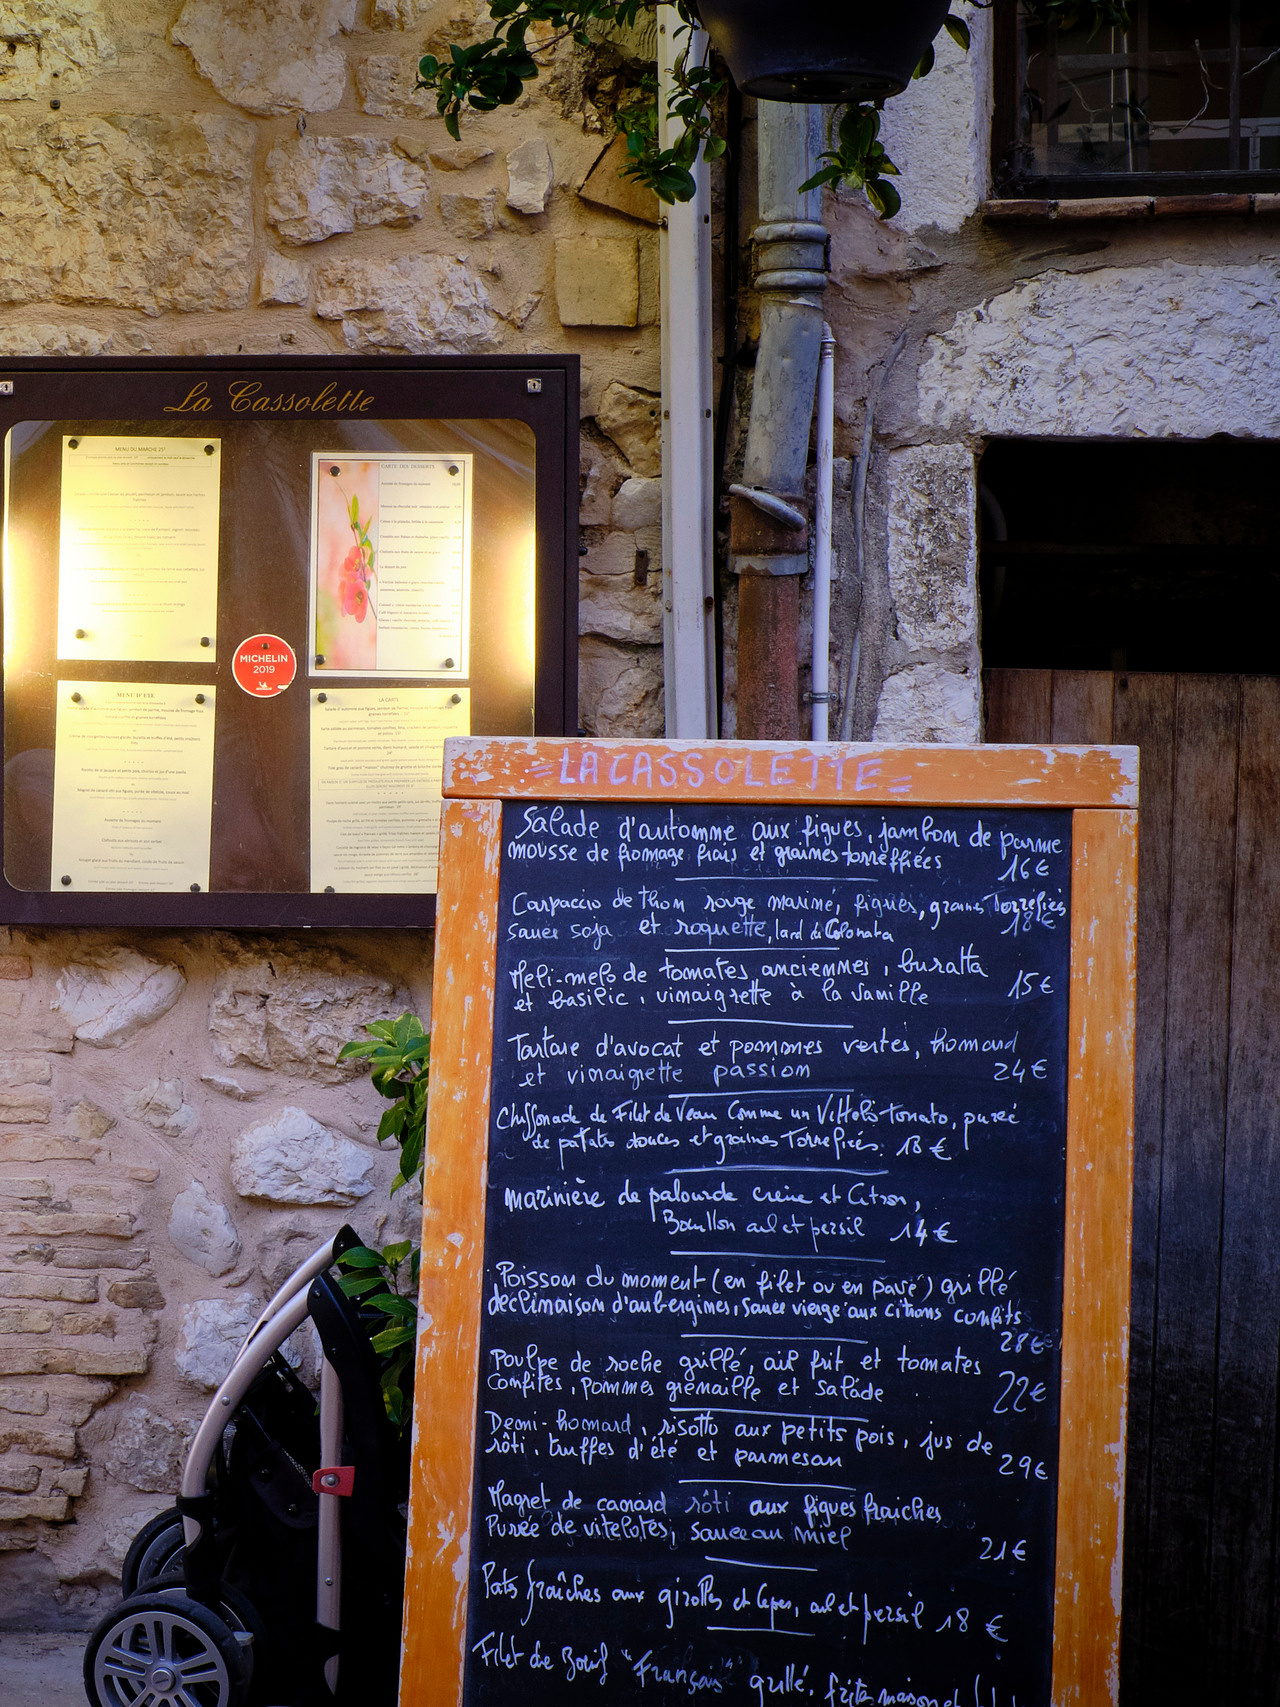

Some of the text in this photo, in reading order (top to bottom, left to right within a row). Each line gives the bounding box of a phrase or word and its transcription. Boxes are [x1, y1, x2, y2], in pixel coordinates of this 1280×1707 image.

[163, 381, 375, 414] La Cassolette
[240, 654, 288, 663] MICHELIN
[253, 665, 276, 674] 2019
[515, 805, 600, 839] Salade
[619, 809, 737, 842] d'automne
[752, 821, 790, 841] aux
[878, 815, 960, 848] jambon
[969, 820, 991, 848] de
[508, 841, 839, 872] mousse de fromage frais et graines
[998, 854, 1050, 881] 16€
[512, 886, 757, 917] Carpaccio de thon rouge
[570, 917, 613, 951] soja
[639, 912, 661, 935] et
[776, 919, 803, 940] lard
[622, 943, 989, 984] de tomates buratta
[513, 978, 843, 1012] et vinaigrette à la
[1007, 970, 1055, 1000] 15€
[507, 1026, 580, 1061] Tartare
[595, 1033, 684, 1058] d'avocat
[697, 1030, 721, 1056] et
[729, 1040, 823, 1064] pommes
[929, 1027, 1020, 1055] homard
[519, 1057, 811, 1091] et vinaigrette passion
[993, 1058, 1049, 1083] 24€
[589, 1104, 608, 1123] de
[611, 1099, 651, 1122] Filet
[654, 1103, 673, 1123] de
[675, 1097, 718, 1123] Veau
[790, 1107, 811, 1121] un
[531, 1134, 551, 1150] de
[689, 1125, 712, 1144] et
[618, 1178, 842, 1223] de palourde et
[782, 1214, 805, 1235] et
[809, 1216, 866, 1254] persil
[495, 1261, 576, 1289] Poisson
[586, 1264, 615, 1288] du
[621, 1265, 706, 1290] moment
[756, 1268, 806, 1300] filet
[813, 1281, 835, 1295] ou
[841, 1281, 863, 1296] en
[940, 1267, 1019, 1304] grillé
[847, 1304, 878, 1320] aux
[953, 1299, 1023, 1331] confits
[489, 1344, 559, 1379] Poulpe
[569, 1350, 592, 1373] de
[605, 1350, 662, 1373] roche
[763, 1350, 800, 1372] ail
[861, 1348, 882, 1371] et
[896, 1344, 982, 1375] tomates
[580, 1379, 655, 1401] pommes
[777, 1377, 800, 1397] et
[548, 1433, 843, 1468] truffes d'été et parmesan
[658, 1411, 994, 1461] risotto aux petits jus de
[999, 1453, 1049, 1480] 29€
[488, 1480, 857, 1529] Magret de canard rôti aux figues
[485, 1514, 541, 1538] Purée
[550, 1515, 578, 1537] de
[979, 1536, 1027, 1561] 21€
[611, 1588, 645, 1603] aux
[733, 1587, 751, 1611] et
[837, 1591, 859, 1616] et
[862, 1591, 924, 1645] persil
[472, 1631, 555, 1671] Filet de
